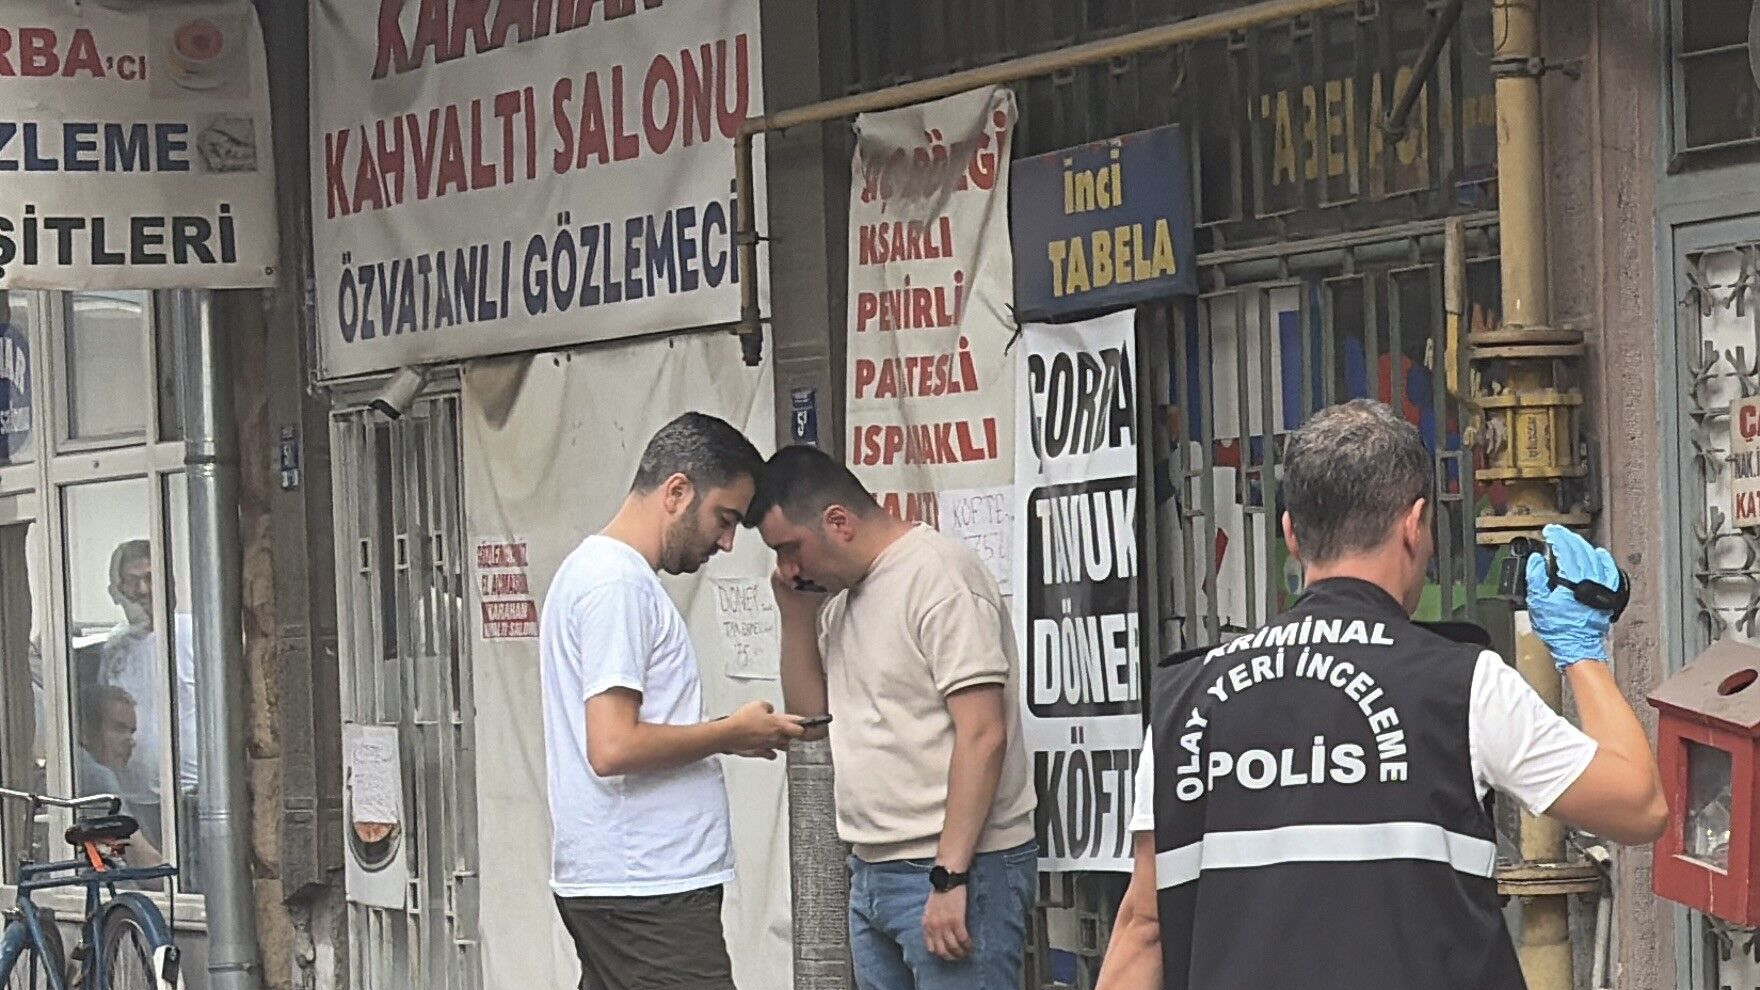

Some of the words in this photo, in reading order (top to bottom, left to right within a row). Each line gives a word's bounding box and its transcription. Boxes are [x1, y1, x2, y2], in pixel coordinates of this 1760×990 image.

[325, 86, 536, 219] KAHVALTI
[553, 33, 749, 174] SALONU
[338, 240, 511, 343] ÖZVATANLI
[523, 178, 740, 315] GÖZLEMECİ
[1048, 218, 1177, 298] TABELA
[1034, 726, 1138, 860] KÖFT
[1176, 707, 1208, 801] OLAY
[1207, 647, 1285, 702] YERİ
[1295, 646, 1408, 782] İNCELEME
[1207, 735, 1367, 792] POLİS
